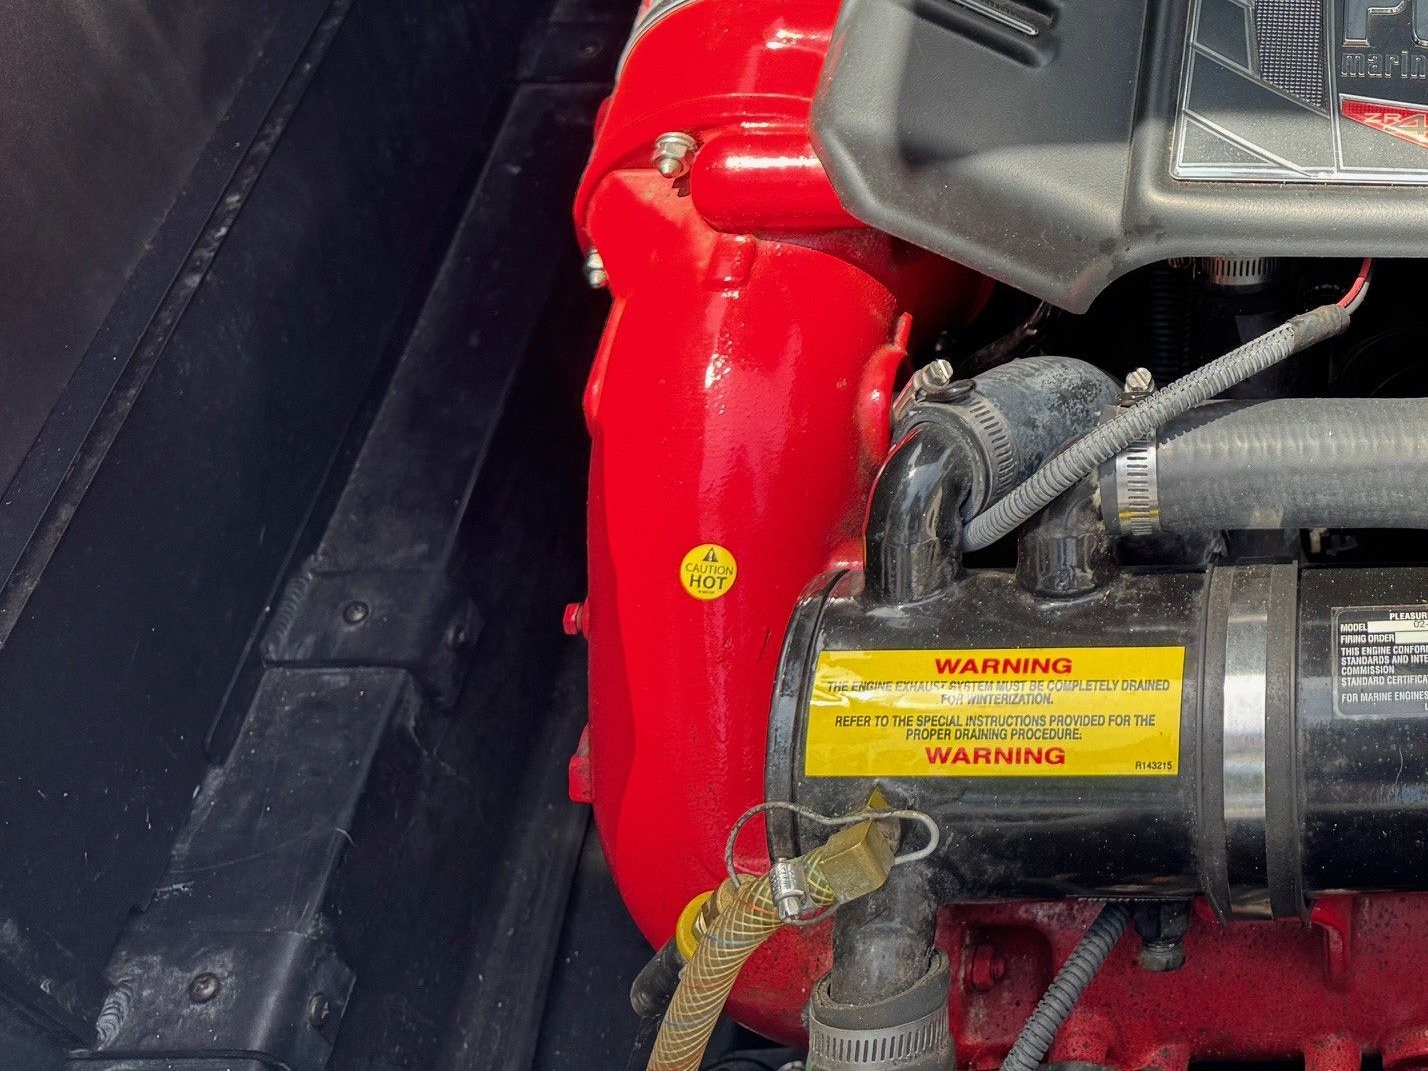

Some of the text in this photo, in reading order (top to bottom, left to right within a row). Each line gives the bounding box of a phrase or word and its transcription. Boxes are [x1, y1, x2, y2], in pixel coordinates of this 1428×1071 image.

[685, 562, 734, 576] CAUTION
[689, 573, 728, 590] HOT
[1340, 623, 1367, 633] MODEL
[1340, 634, 1367, 644] FIRING
[1368, 633, 1395, 643] ORDER
[1341, 646, 1360, 656] THIS
[1361, 645, 1392, 655] ENGINE
[1341, 655, 1390, 666] STANDARDS
[1391, 654, 1409, 664] AND
[935, 658, 1073, 675] WARNING
[1341, 665, 1395, 676] COMMISSION
[827, 679, 1170, 692] THE ENGINE EXHAUST SYSTEM MUST BE COMPLETELY DRAINED
[1341, 676, 1385, 687] STANDARD
[941, 693, 1054, 705] FOR WINTERIZATION.
[1341, 693, 1359, 703] FOR
[1360, 691, 1393, 702] MARINE
[835, 714, 1156, 727] REFER TO THE SPECIAL INSTRUCTIONS PROVIDED FOR THE
[906, 728, 951, 740] PROPER
[954, 728, 1008, 740] DRAINING
[925, 747, 1066, 765] WARNING
[1135, 760, 1173, 771] R143215
